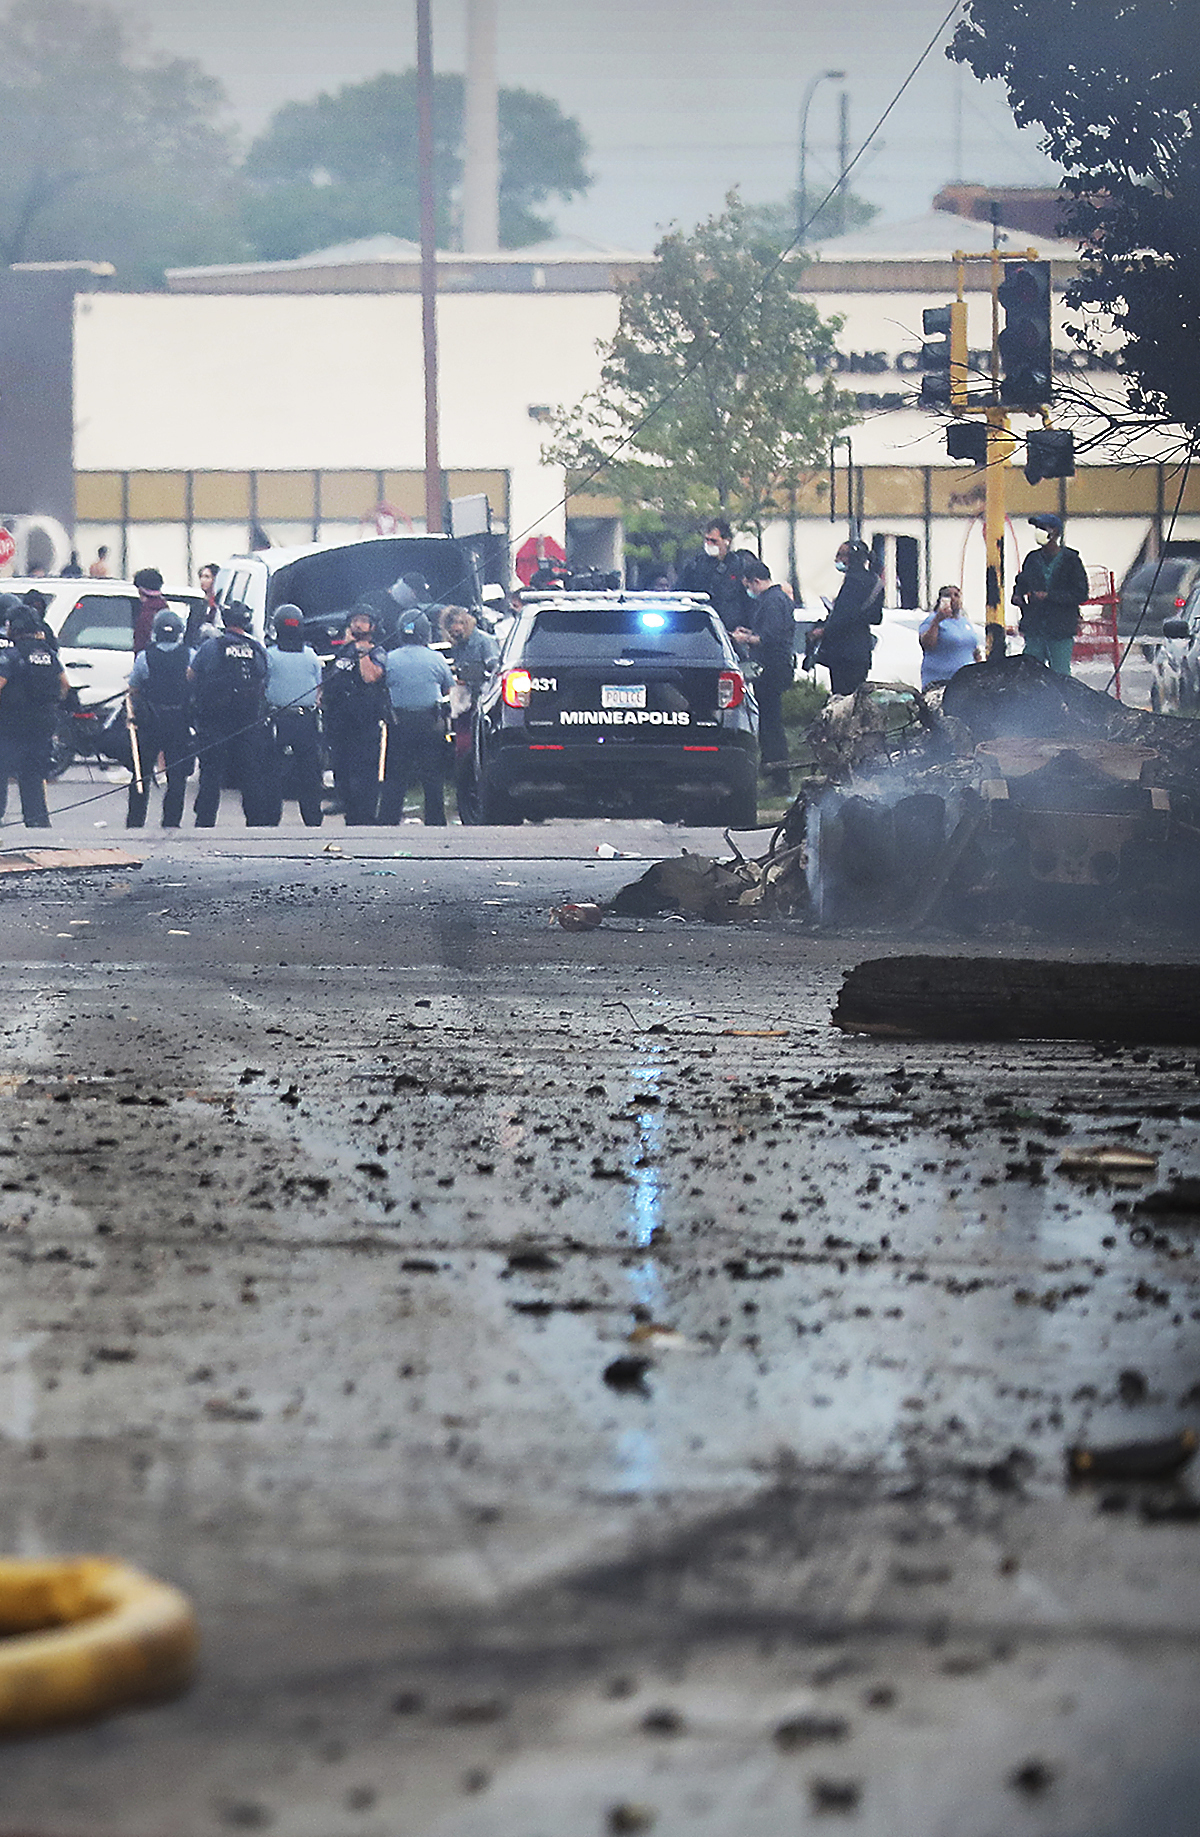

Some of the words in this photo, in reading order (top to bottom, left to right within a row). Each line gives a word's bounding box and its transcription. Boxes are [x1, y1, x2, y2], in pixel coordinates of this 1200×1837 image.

[225, 646, 254, 659] POLICE
[606, 691, 642, 704] POLICE
[560, 711, 691, 726] MINNEAPOLIS
